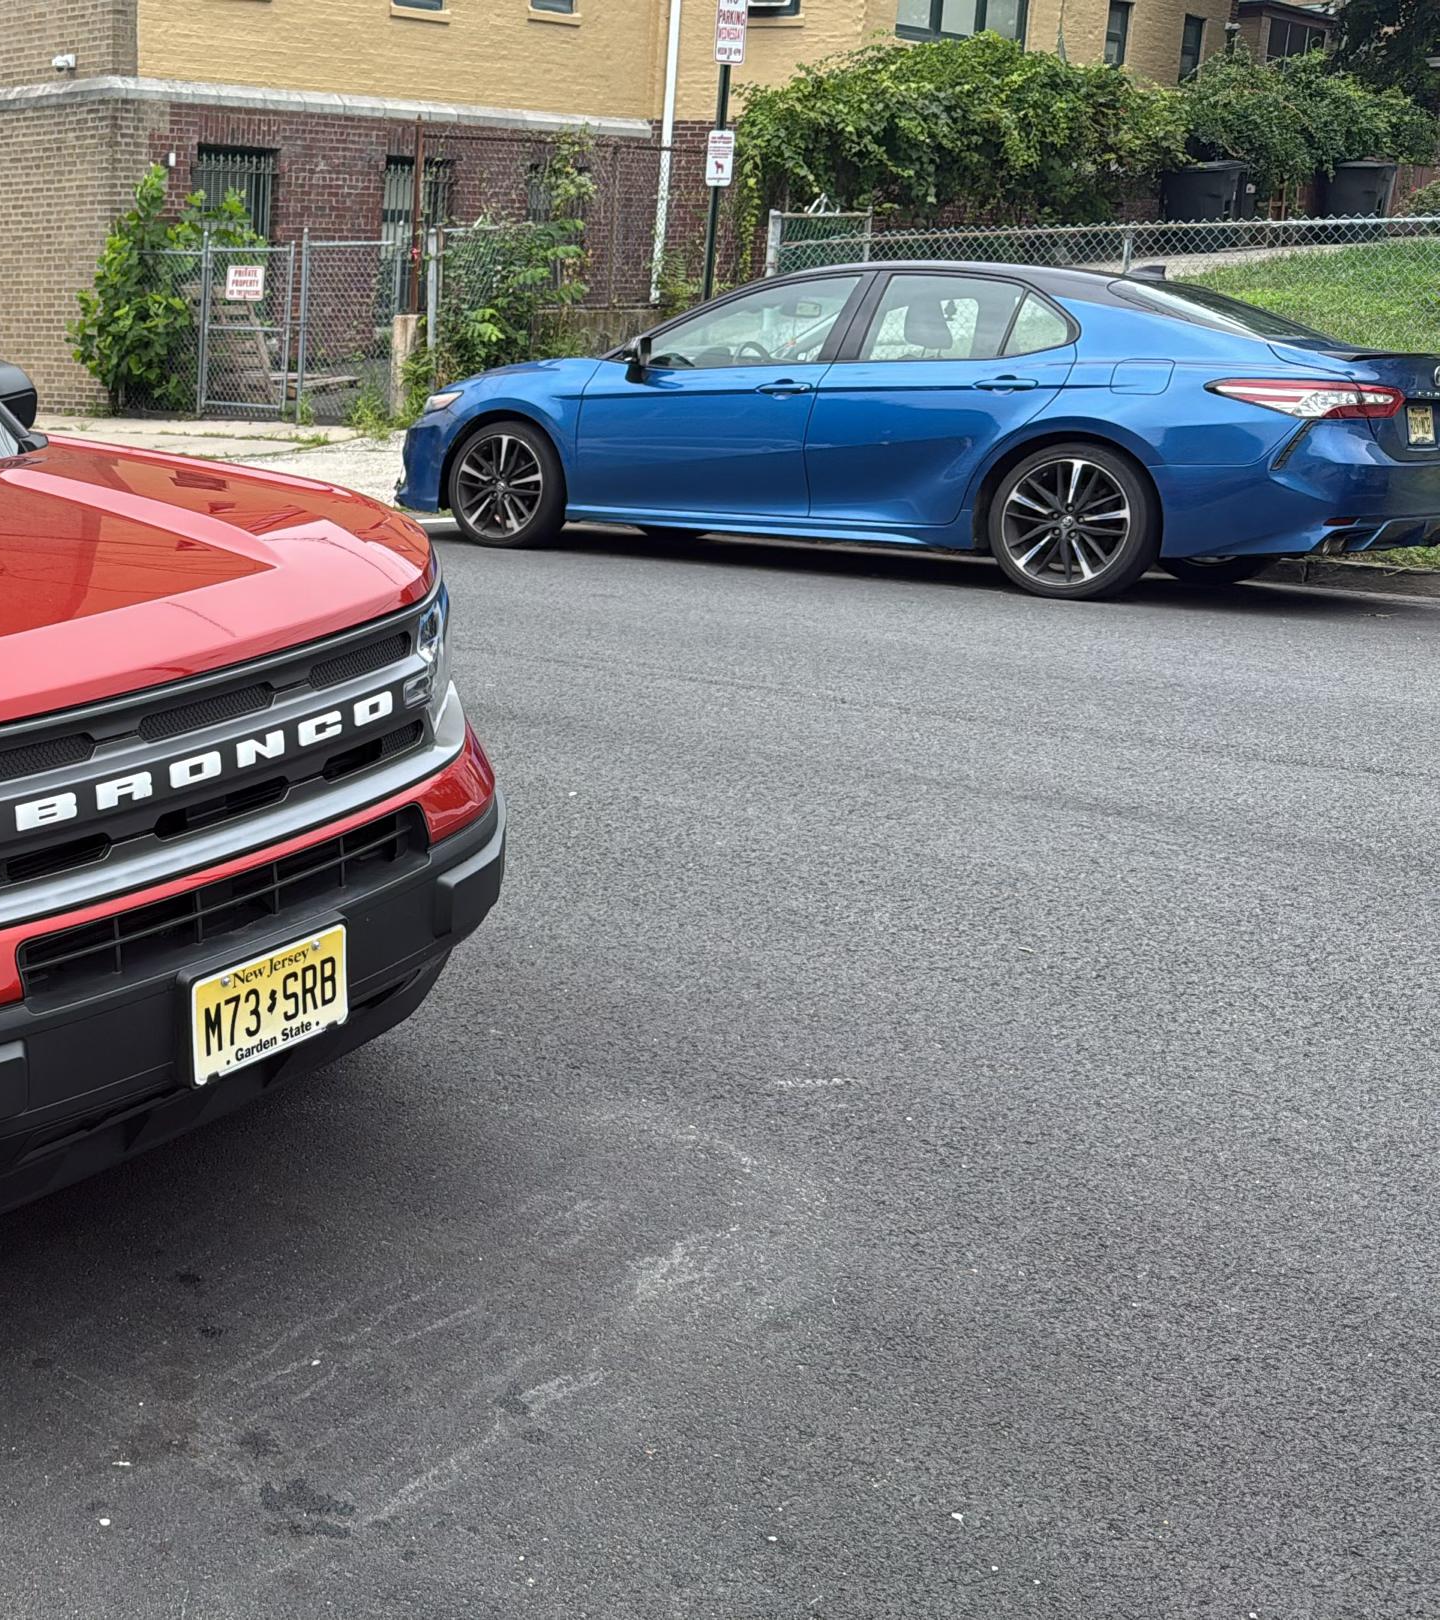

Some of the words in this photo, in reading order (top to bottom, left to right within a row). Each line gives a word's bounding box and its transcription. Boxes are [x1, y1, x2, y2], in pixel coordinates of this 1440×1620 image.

[718, 9, 745, 26] PARKING
[15, 690, 393, 831] BRONCO
[232, 965, 265, 988] New
[267, 947, 309, 977] Jersey
[235, 1035, 277, 1062] Garden
[281, 1021, 311, 1041] State
